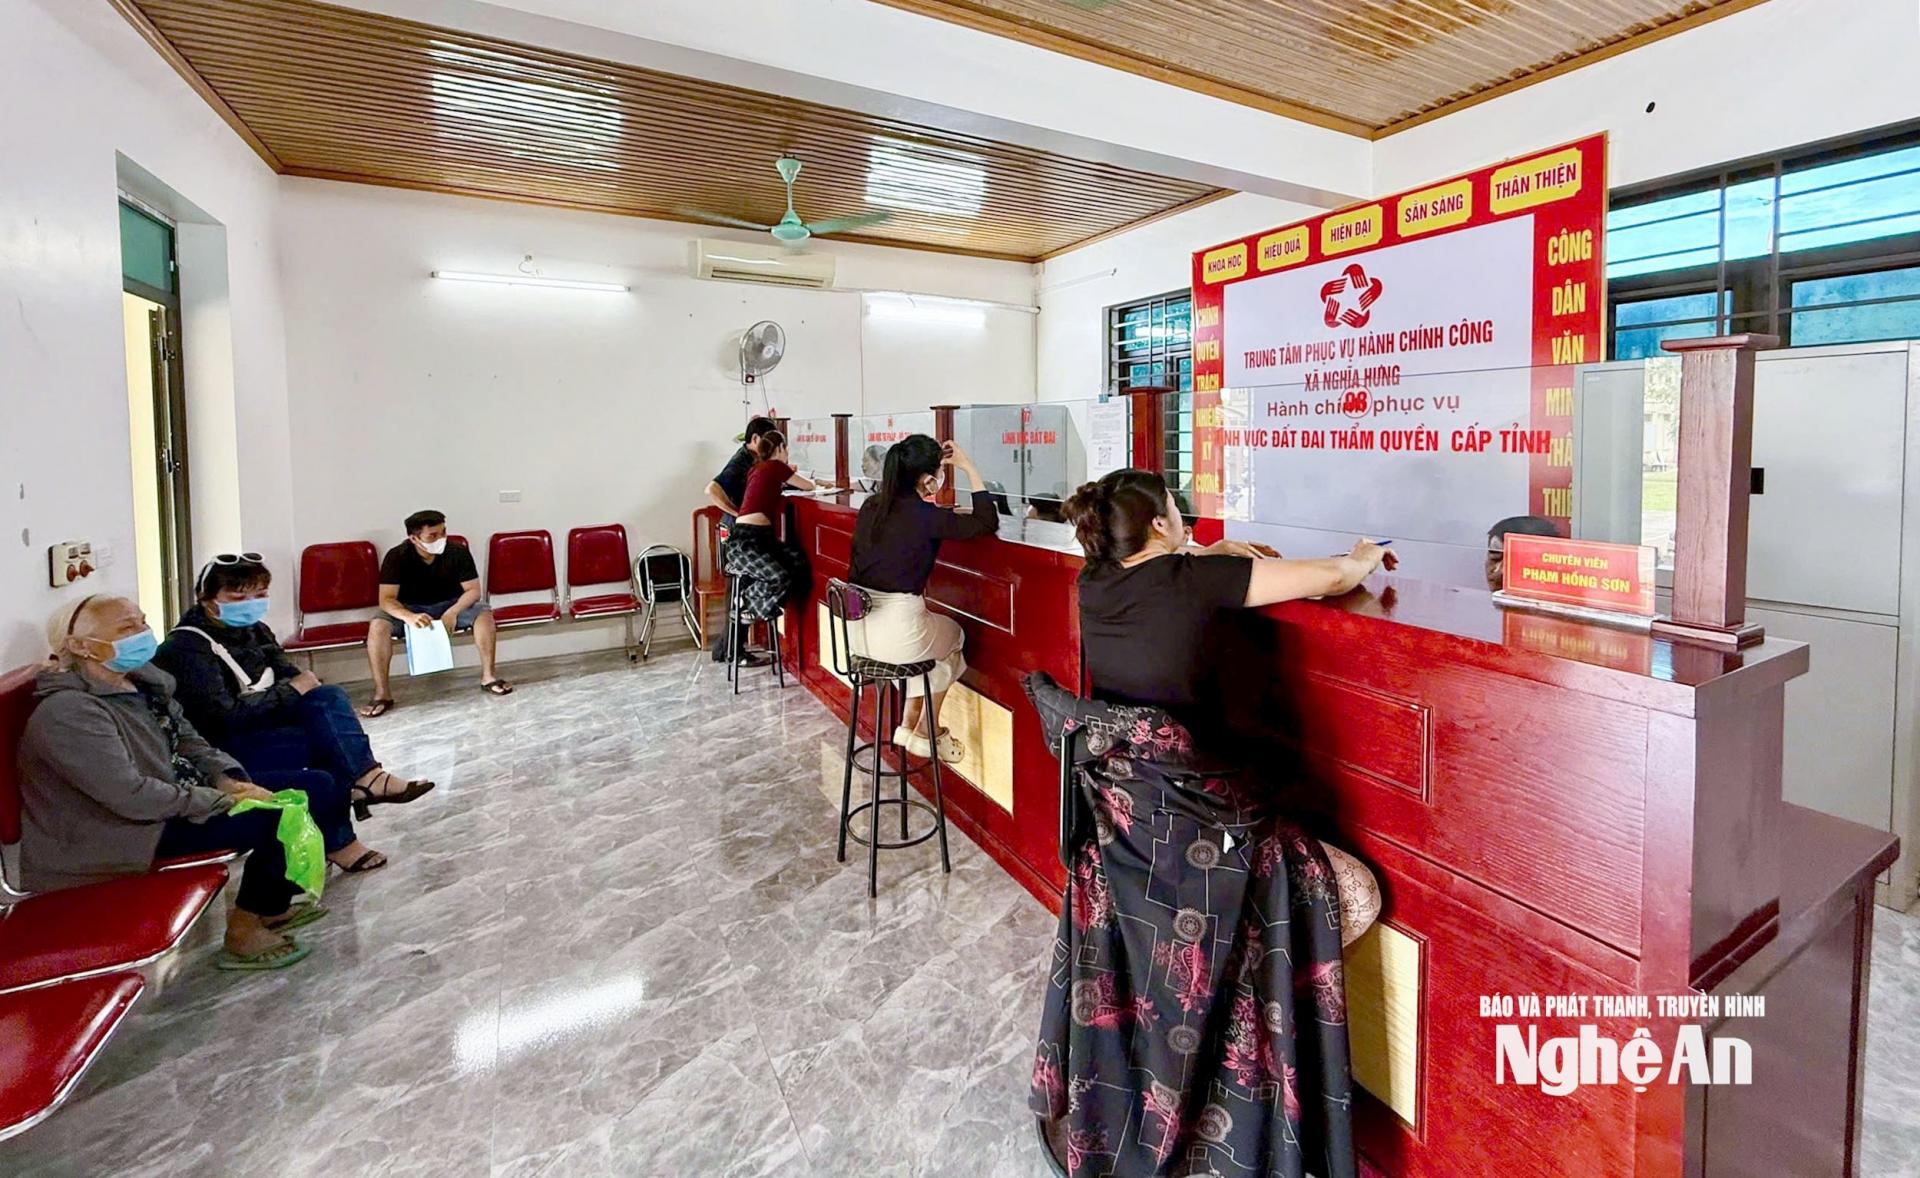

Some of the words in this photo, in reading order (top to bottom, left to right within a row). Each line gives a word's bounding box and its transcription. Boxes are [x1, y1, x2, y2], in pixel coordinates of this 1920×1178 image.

[1495, 175, 1530, 200] THÂN
[1535, 162, 1576, 189] THIỆN
[1404, 200, 1428, 223] SẴN
[1431, 193, 1464, 217] SÀNG
[1330, 222, 1352, 244] HIỆN
[1355, 218, 1372, 238] ĐẠI
[1264, 243, 1282, 262] HIỆU
[1284, 233, 1301, 256] QUẢ
[1548, 227, 1593, 266] CÔNG
[1208, 258, 1226, 273] KHOA
[1227, 254, 1242, 271] HỌC
[1552, 278, 1586, 317] DÂN
[1244, 348, 1276, 369] TRUNG
[1279, 342, 1301, 366] TÂM
[1305, 340, 1336, 366] PHỤC
[1339, 337, 1355, 363] VỤ
[1358, 331, 1395, 357] HÀNH
[1399, 323, 1444, 353] CHÍNH
[1449, 318, 1493, 347] CÔNG
[1551, 330, 1585, 366] VĂN
[1304, 369, 1320, 392] XÃ
[1323, 364, 1360, 392] NGHĨA
[1364, 364, 1400, 388] HƯNG
[1267, 400, 1309, 417] Hành
[1314, 396, 1366, 415] chí
[1373, 395, 1425, 417] phục
[1433, 395, 1460, 414] vụ
[1546, 387, 1574, 417] MIN
[1244, 428, 1268, 451] VỰC
[1272, 423, 1297, 449] ĐẤT
[1301, 430, 1325, 448] ĐAI
[1330, 422, 1374, 450] THẨM
[1380, 422, 1439, 453] QUYỀN
[1451, 421, 1492, 453] CẤP
[1499, 422, 1551, 453] TỈNH
[1547, 431, 1573, 467] THÂ
[1542, 552, 1582, 567] CHUYÊN
[1584, 555, 1609, 570] VIÊN
[1522, 567, 1559, 585] PHẠM
[1601, 577, 1631, 593] SƠN
